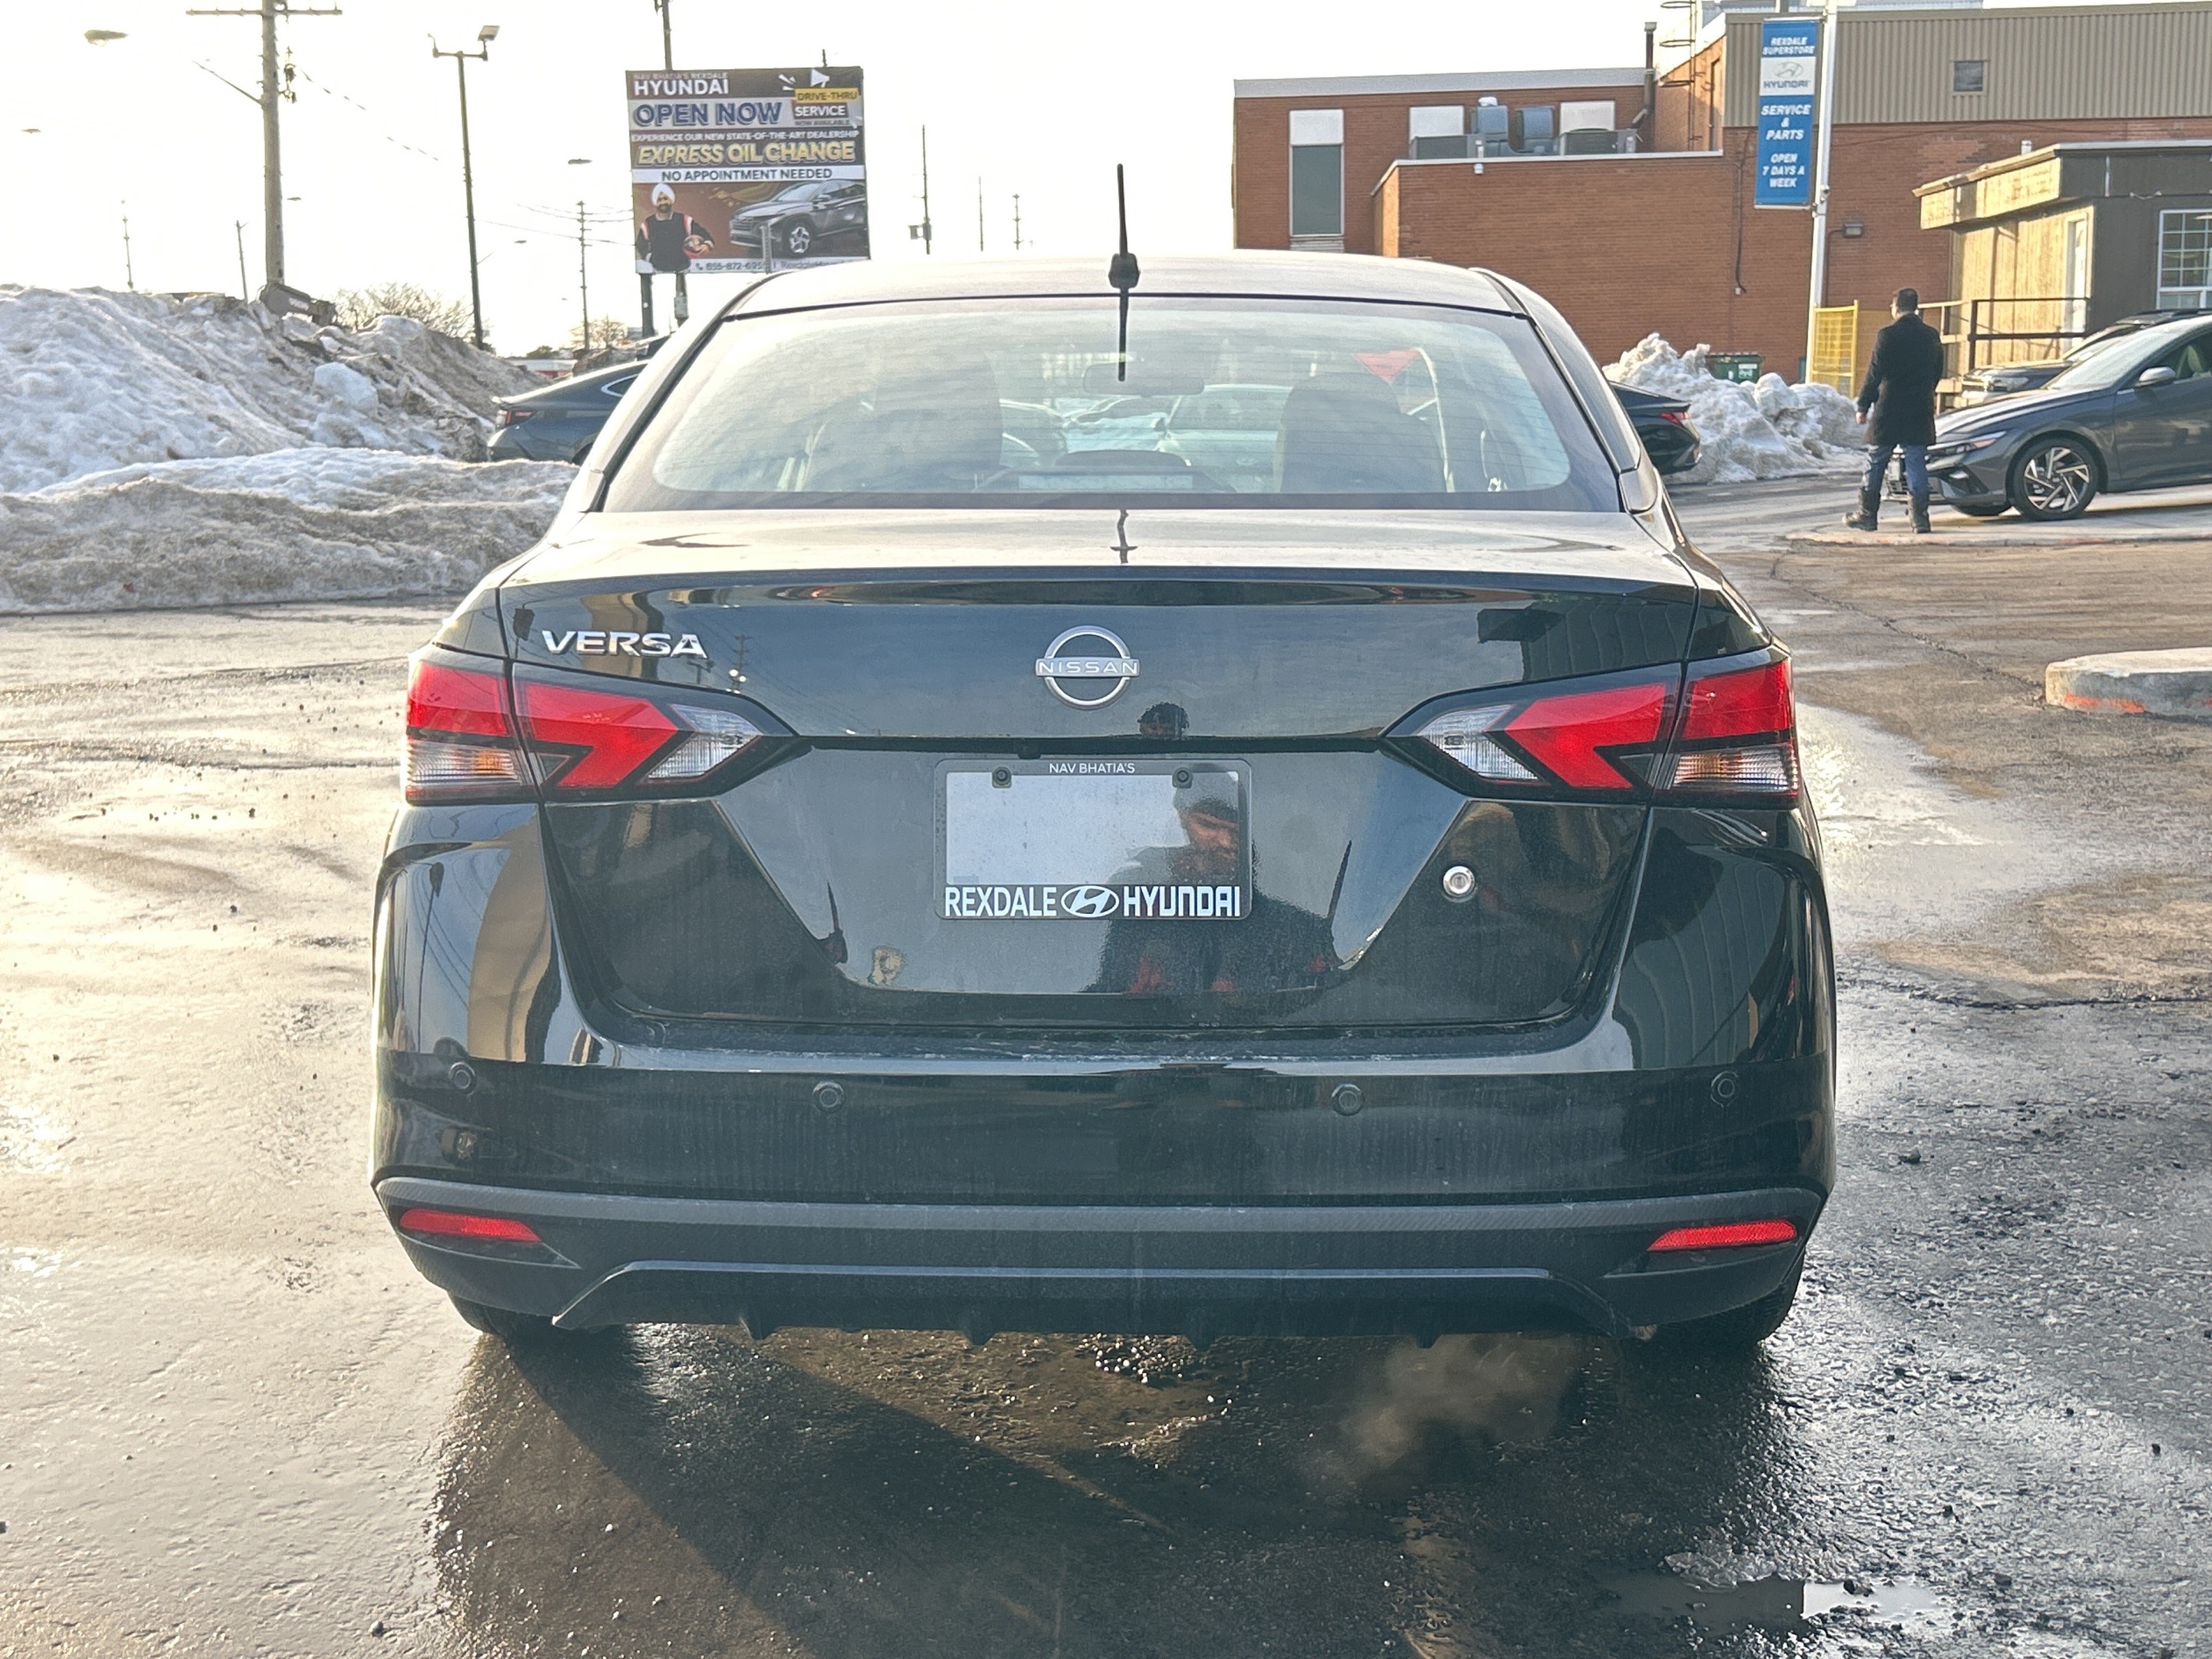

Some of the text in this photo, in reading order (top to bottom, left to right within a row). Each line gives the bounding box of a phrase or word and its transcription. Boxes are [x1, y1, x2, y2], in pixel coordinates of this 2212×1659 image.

[1770, 37, 1808, 46] REXDALE
[1763, 46, 1815, 55] SUPERSTORE
[634, 79, 729, 95] HYUNDAI
[1763, 80, 1809, 88] HYUNDAI
[797, 91, 857, 101] DRIVE-THRU
[634, 101, 783, 127] OPEN NOW
[794, 105, 846, 117] SERVICE
[1761, 104, 1811, 115] SERVICE
[1781, 118, 1790, 127] &
[631, 130, 859, 142] EXPERIENCE OUR NEW STATE-OF-THE-ART DEALERSHIP
[1766, 129, 1804, 140] PARTS
[637, 141, 856, 167] EXPRESS OIL CHANGE
[1770, 153, 1798, 164] OPEN
[662, 168, 832, 181] NO APPOINTMENT NEEDED
[1762, 165, 1806, 176] 7 DAYS A
[1770, 177, 1797, 187] WEEK
[541, 630, 708, 659] VERSA
[1038, 661, 1137, 674] NISSAN
[1049, 763, 1135, 773] NAV BHATIA'S
[945, 886, 1240, 917] REXDALE HYUNDAI
